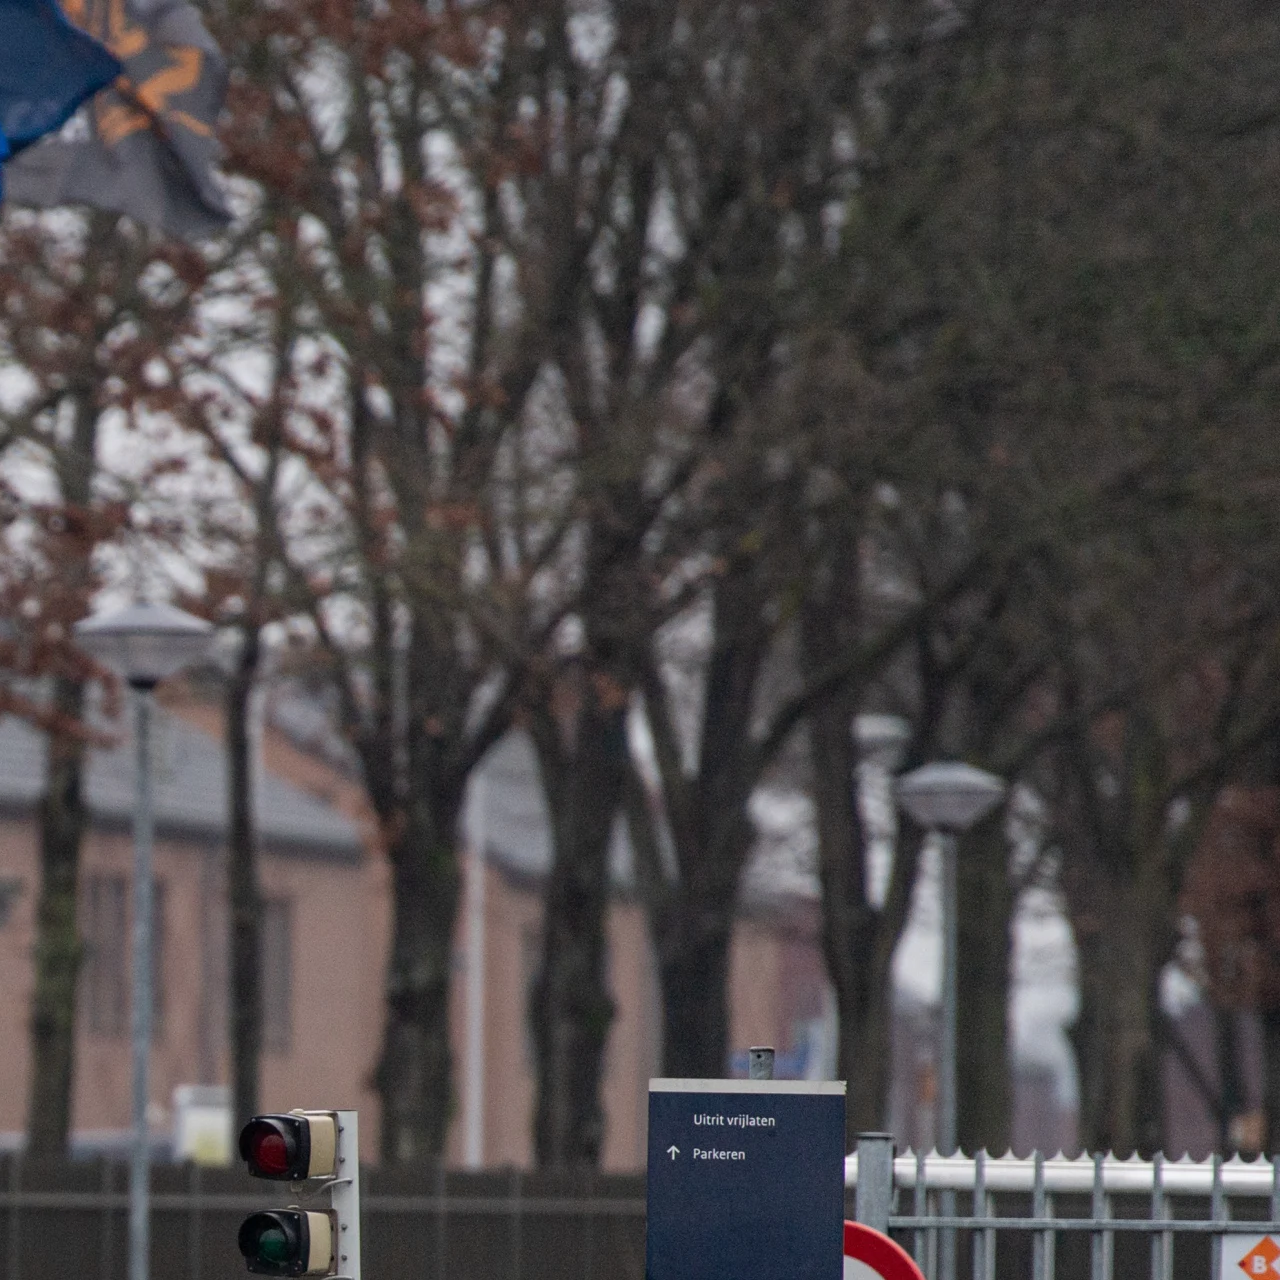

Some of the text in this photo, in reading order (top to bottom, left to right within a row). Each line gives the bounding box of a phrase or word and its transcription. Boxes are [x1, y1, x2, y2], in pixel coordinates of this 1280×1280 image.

[693, 1114, 776, 1129] Uitrit vrijlaten
[693, 1149, 746, 1160] Parkeren
